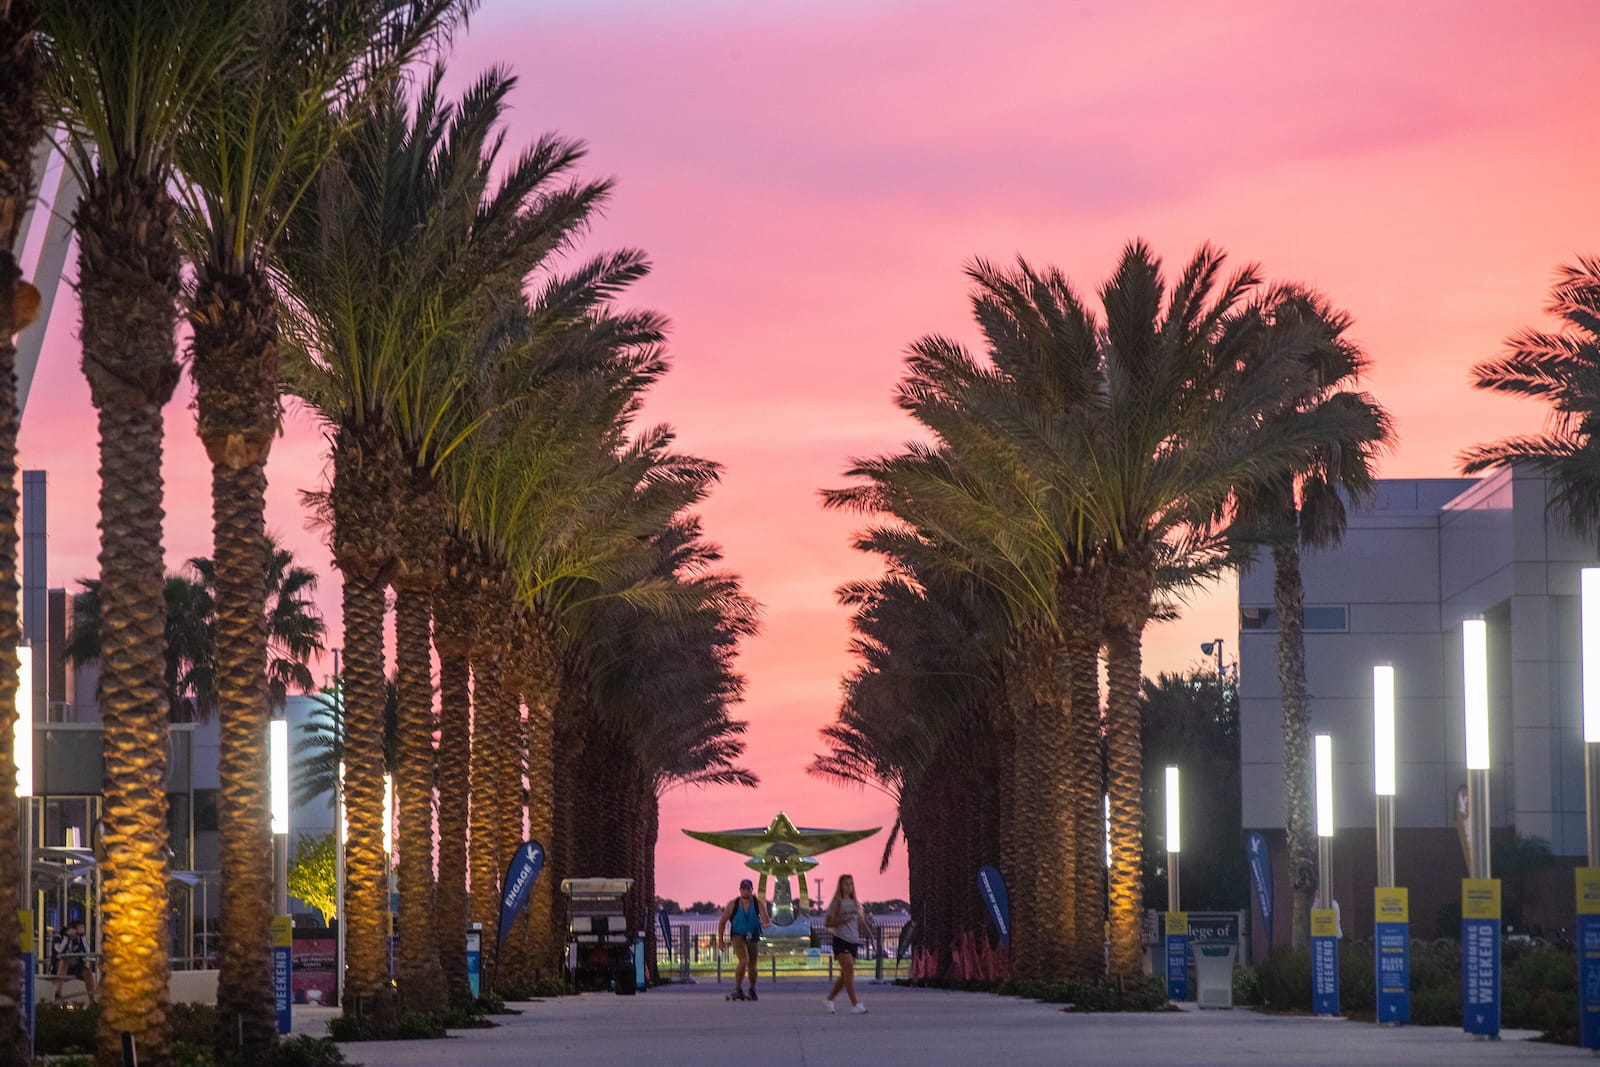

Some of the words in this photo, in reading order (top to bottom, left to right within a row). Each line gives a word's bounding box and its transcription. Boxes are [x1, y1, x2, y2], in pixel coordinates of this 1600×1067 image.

[505, 863, 532, 907] ENGAGE
[1188, 924, 1214, 939] lege
[1217, 924, 1231, 936] of
[276, 951, 287, 1011] WEEKEND
[1323, 941, 1334, 993] WEEKEND
[1468, 925, 1478, 1003] HOMECOMING
[1479, 925, 1493, 1003] WEEKEND
